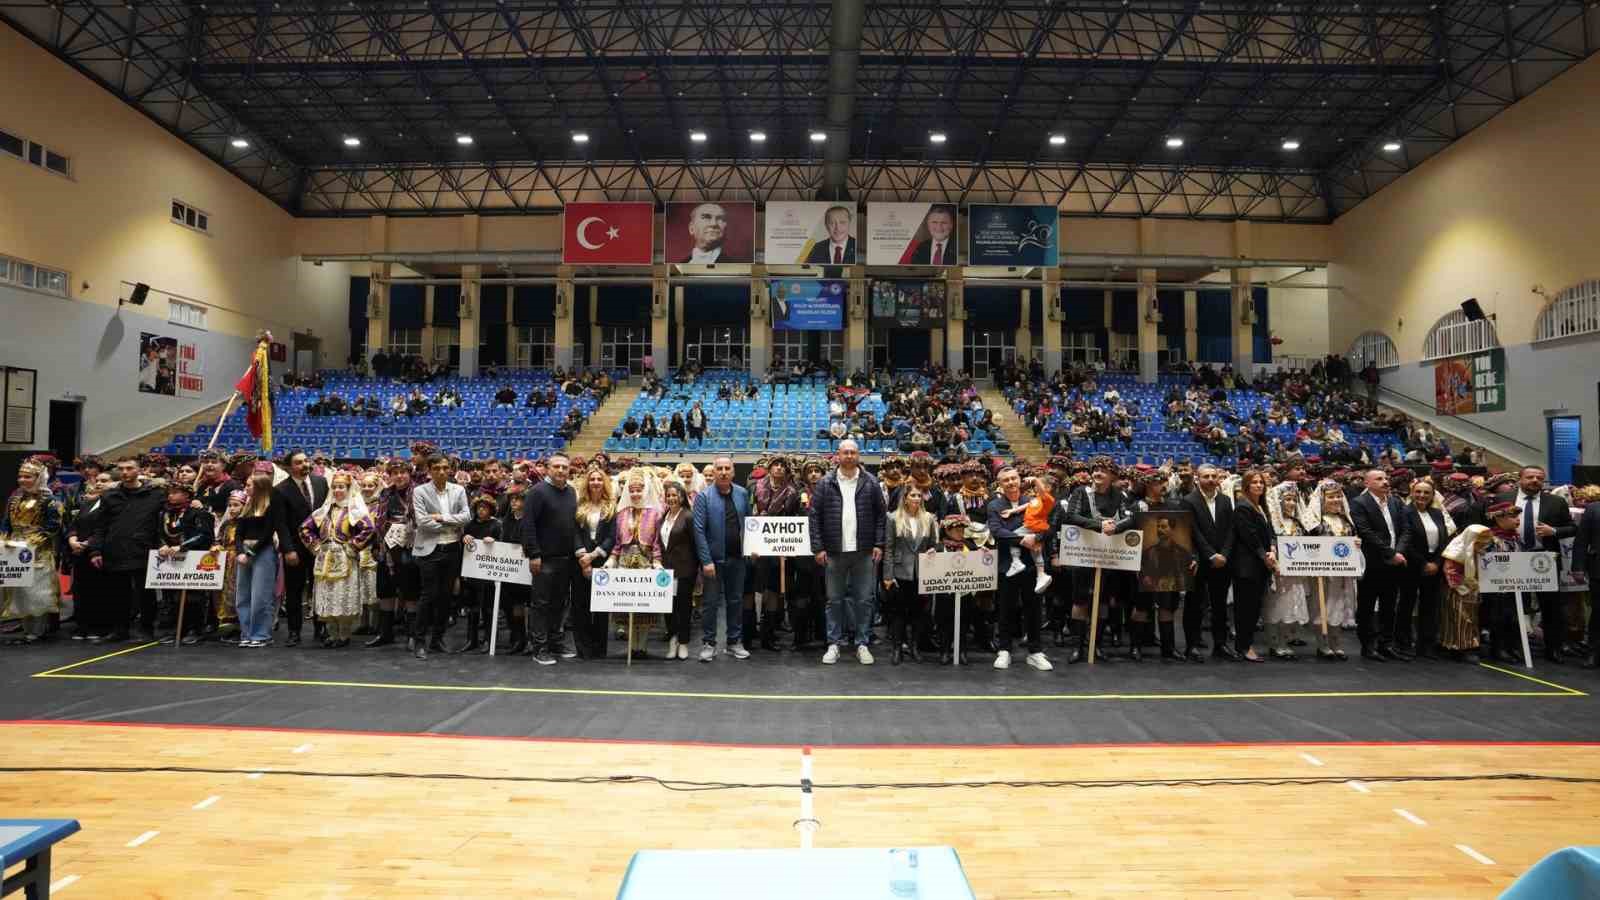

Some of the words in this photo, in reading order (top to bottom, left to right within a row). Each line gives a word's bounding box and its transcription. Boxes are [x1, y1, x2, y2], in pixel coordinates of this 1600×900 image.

[762, 522, 805, 534] AYHOT
[476, 554, 498, 563] DERİN
[499, 558, 524, 566] SANAT
